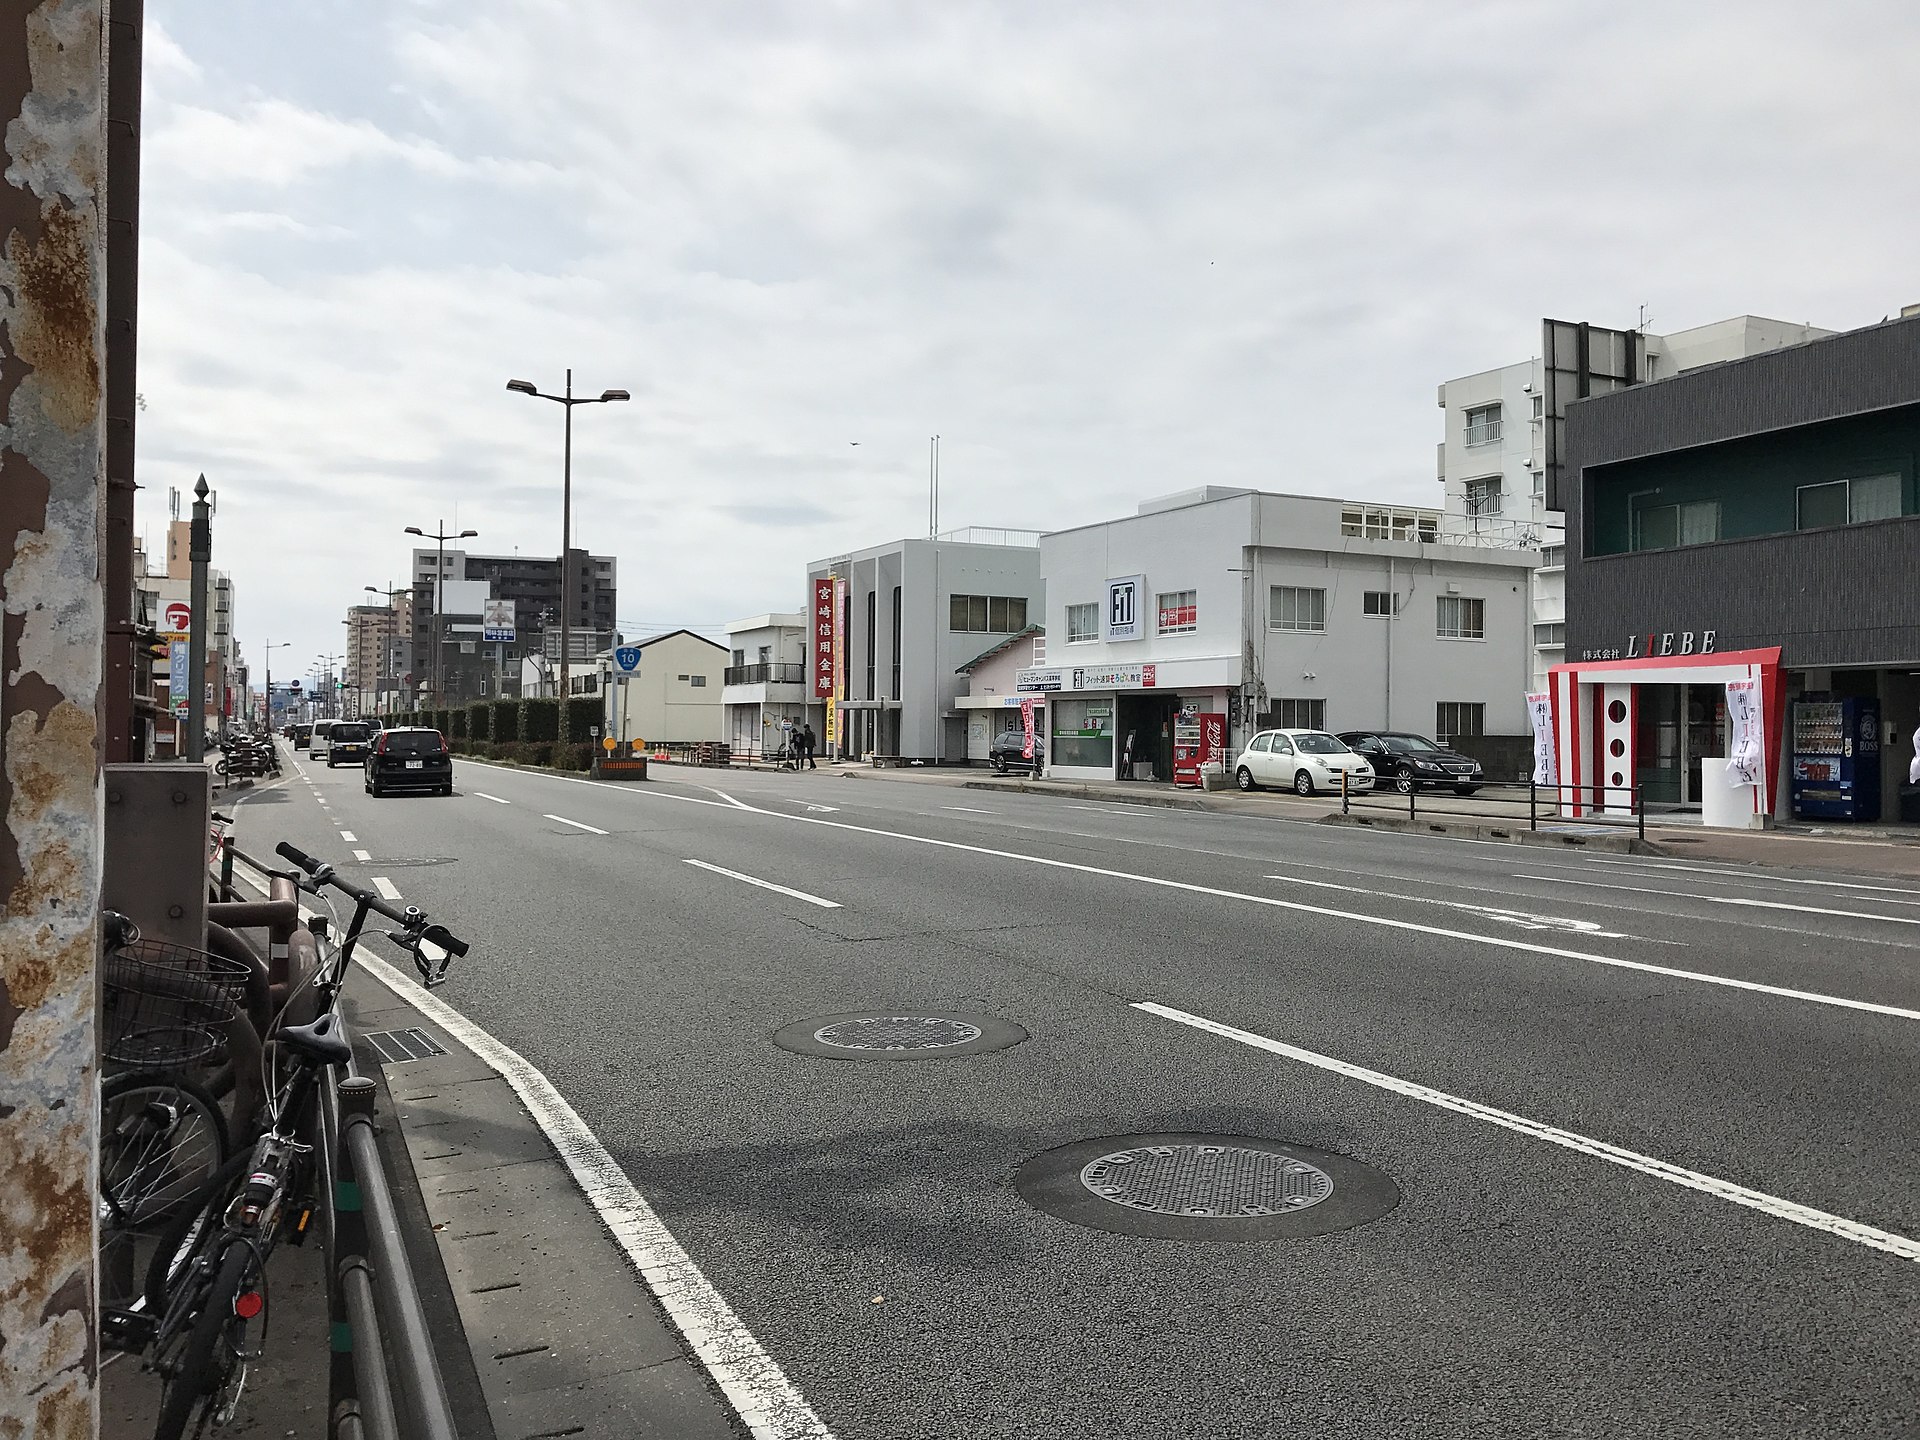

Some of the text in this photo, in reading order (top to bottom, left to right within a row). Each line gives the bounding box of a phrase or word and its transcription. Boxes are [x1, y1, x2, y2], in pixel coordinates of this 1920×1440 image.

[818, 586, 832, 690] 宮崎信用金庫
[1582, 630, 1716, 660] 株式会社 LIEBE
[621, 653, 635, 663] 10
[1859, 741, 1878, 751] BOSS
